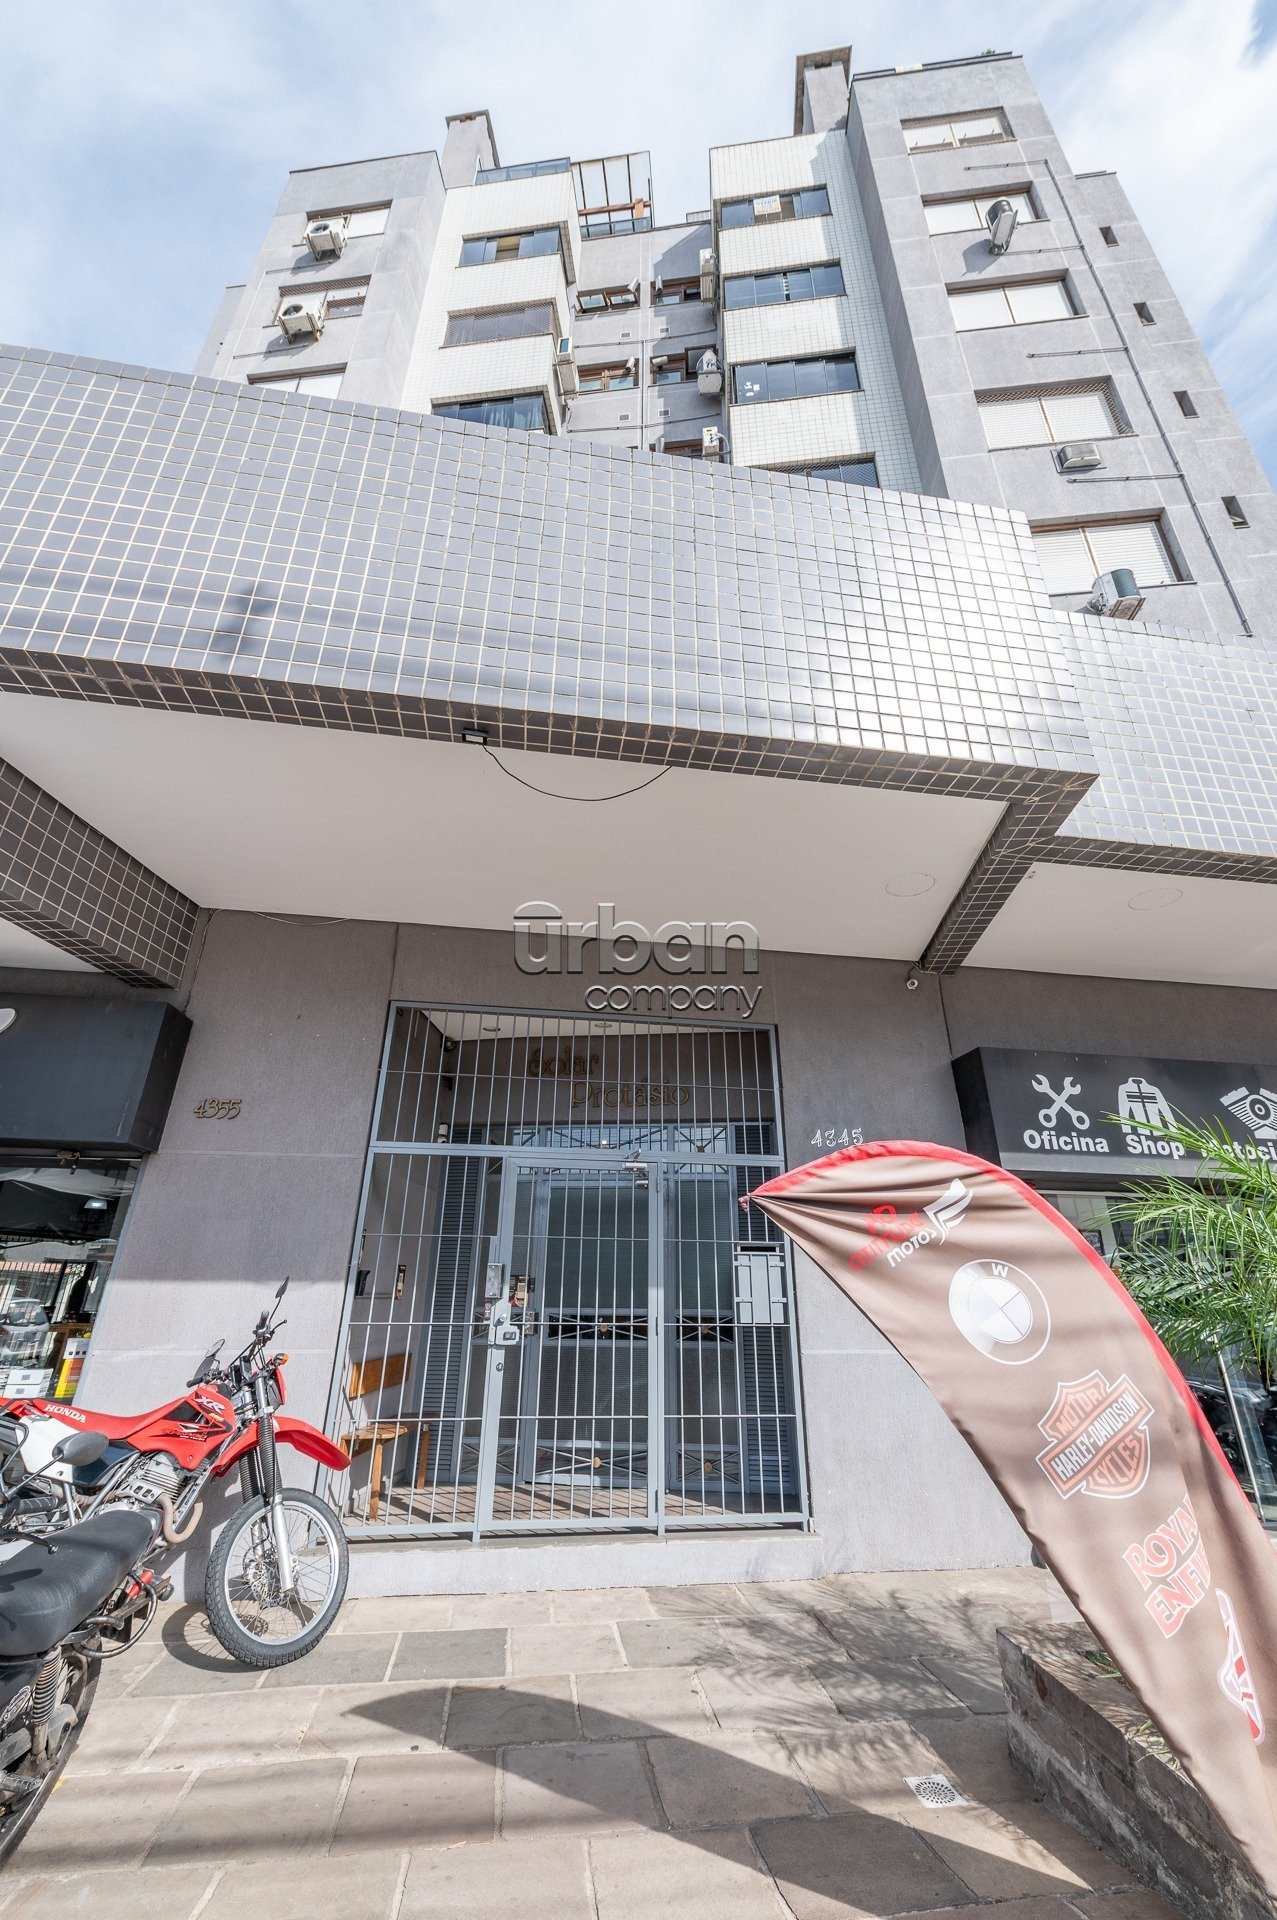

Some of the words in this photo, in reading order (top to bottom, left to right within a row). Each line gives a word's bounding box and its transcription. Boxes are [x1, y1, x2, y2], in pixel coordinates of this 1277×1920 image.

[527, 1045, 599, 1077] Solar
[194, 1098, 242, 1120] 4355
[811, 1127, 864, 1147] 4345
[1023, 1129, 1110, 1153] Oficina
[1125, 1134, 1185, 1160] Shop
[44, 1404, 87, 1424] HONDA
[194, 1395, 226, 1415] XR
[1056, 1387, 1103, 1436] MOTOR
[1050, 1390, 1140, 1482] HARLEY-DAVIDSON
[1092, 1434, 1140, 1485] CYCLES
